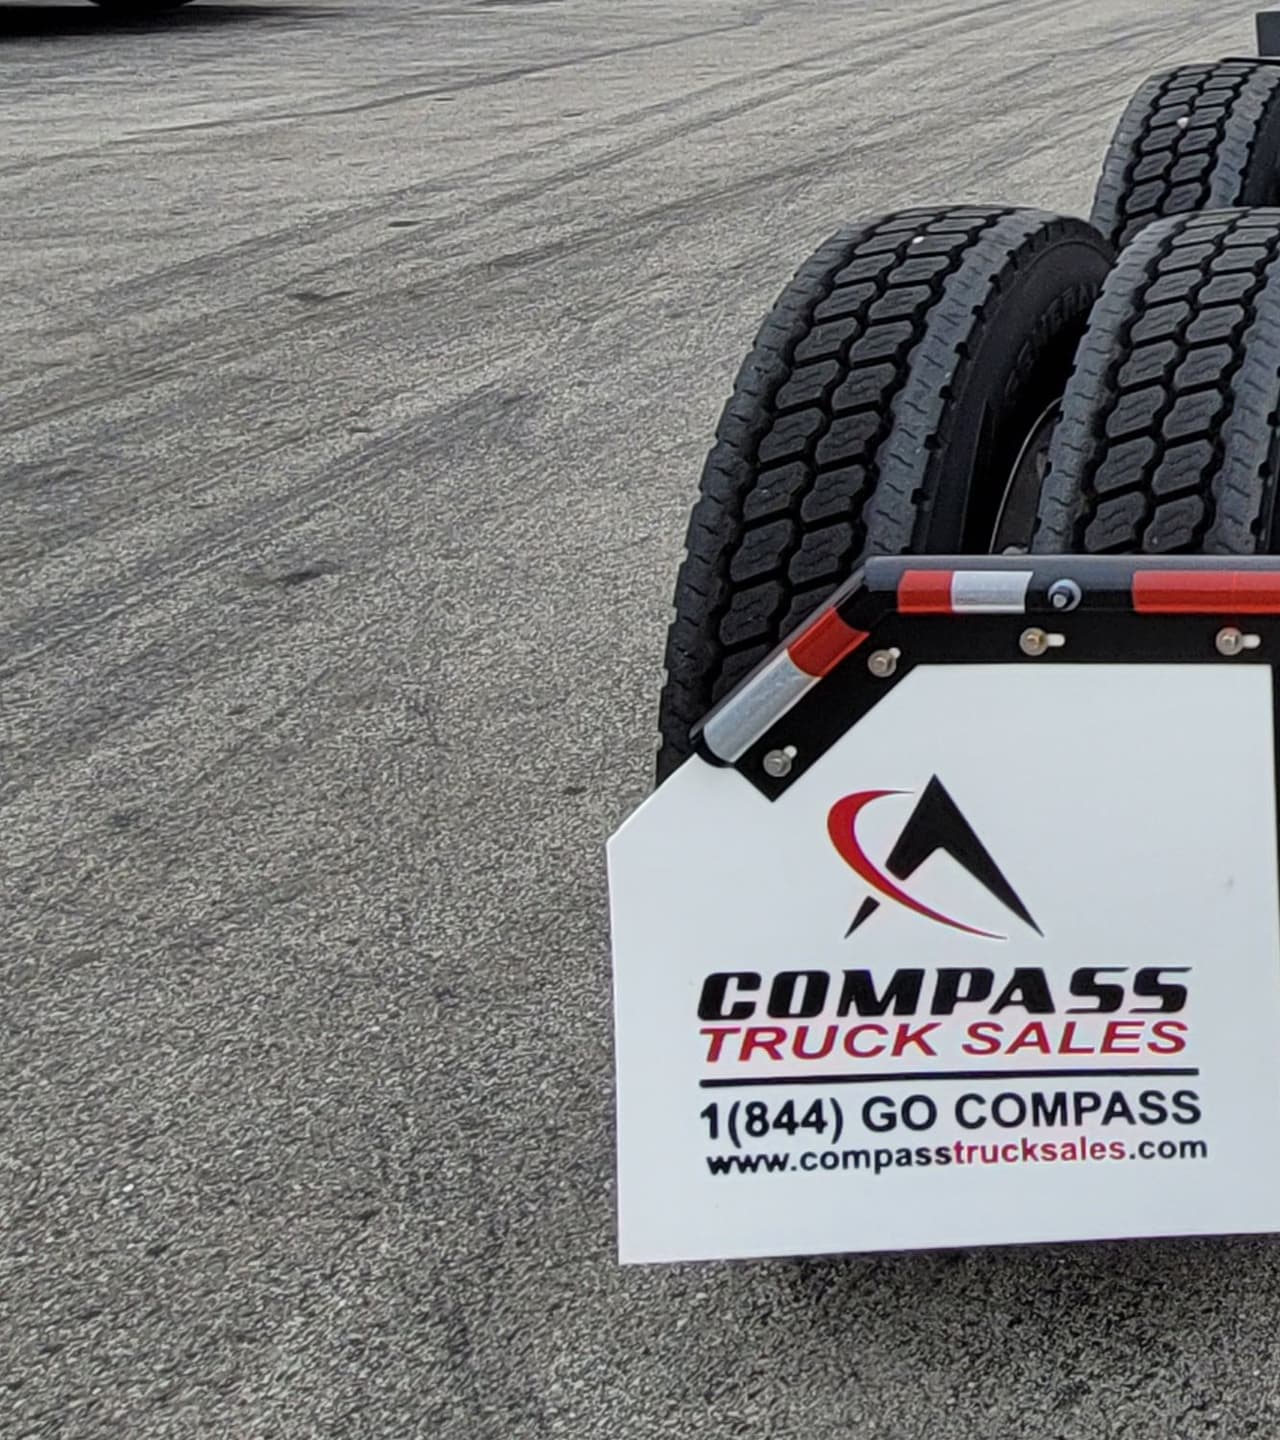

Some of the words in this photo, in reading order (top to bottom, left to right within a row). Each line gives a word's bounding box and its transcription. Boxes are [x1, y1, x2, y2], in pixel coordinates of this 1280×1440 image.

[698, 967, 1191, 1021] COMPASS
[700, 1023, 938, 1063] TRUCK
[962, 1020, 1188, 1055] SALES
[700, 1097, 843, 1147] 1(844)
[862, 1094, 937, 1133] GO
[955, 1090, 1201, 1129] COMPASS
[706, 1136, 1207, 1176] www.compasstrucksales.com
